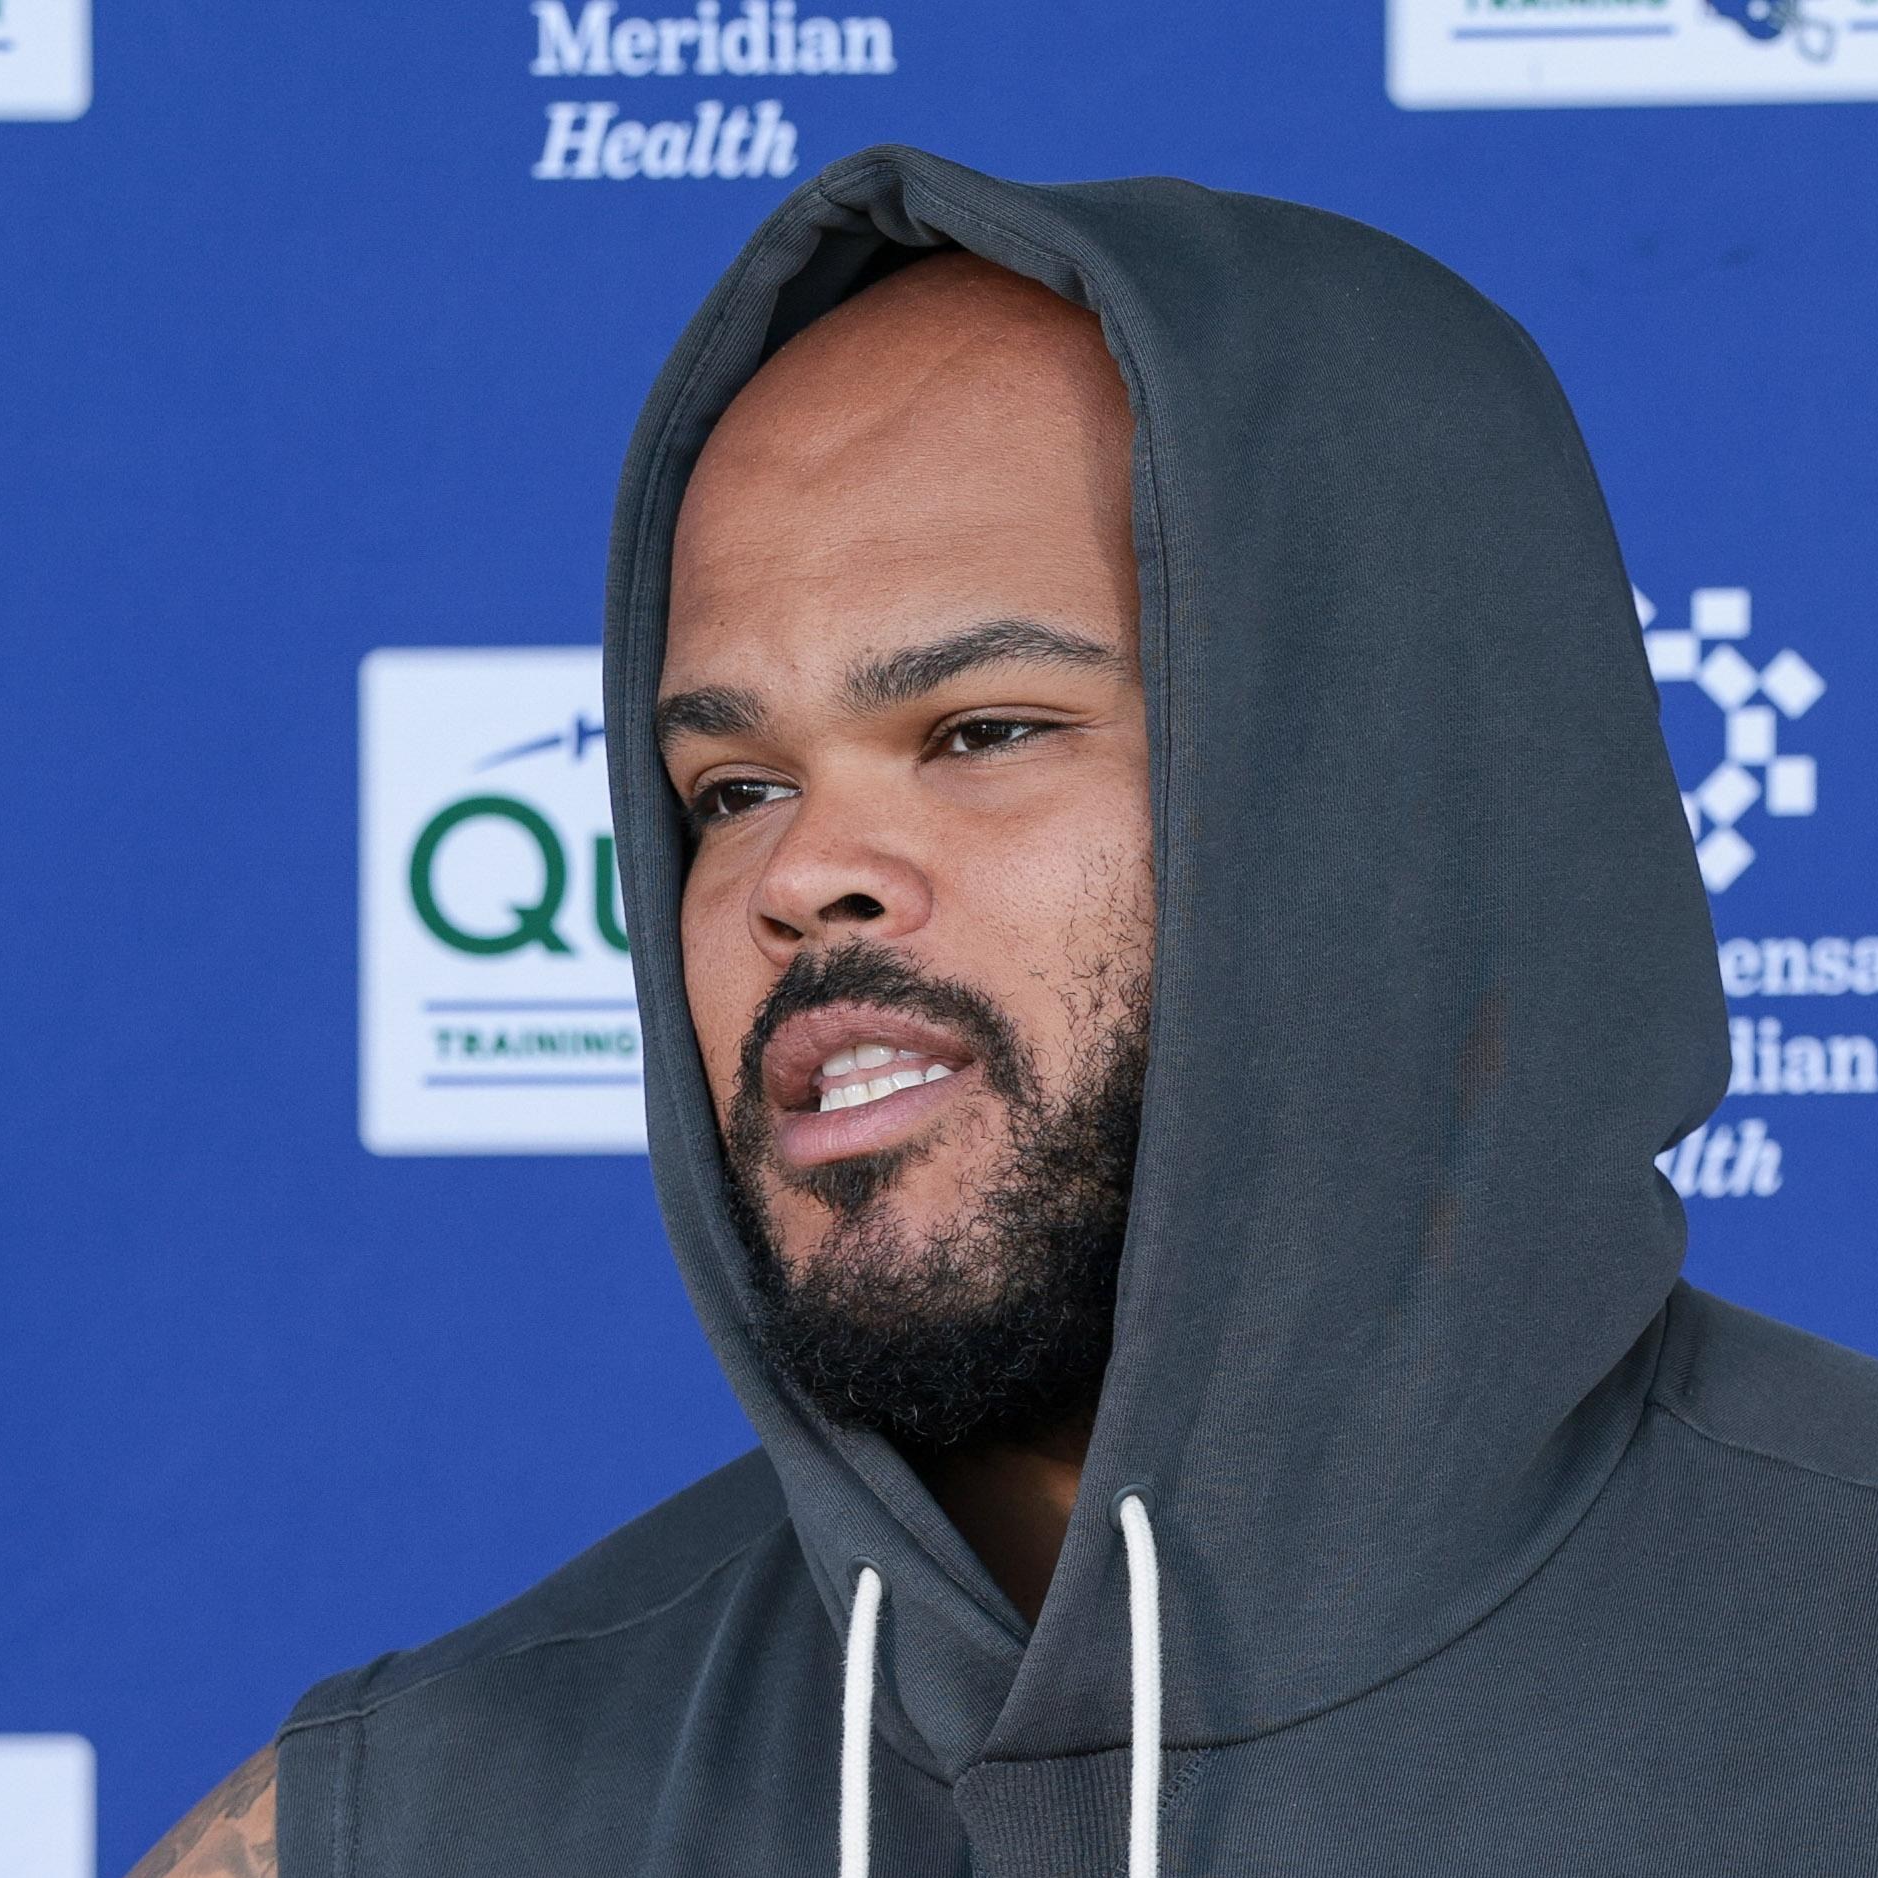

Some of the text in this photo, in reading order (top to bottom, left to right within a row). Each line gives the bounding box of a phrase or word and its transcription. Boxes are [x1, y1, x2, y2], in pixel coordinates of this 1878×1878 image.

[531, 0, 896, 76] Meridian
[533, 100, 798, 179] Health
[1654, 1119, 1782, 1199] lth
